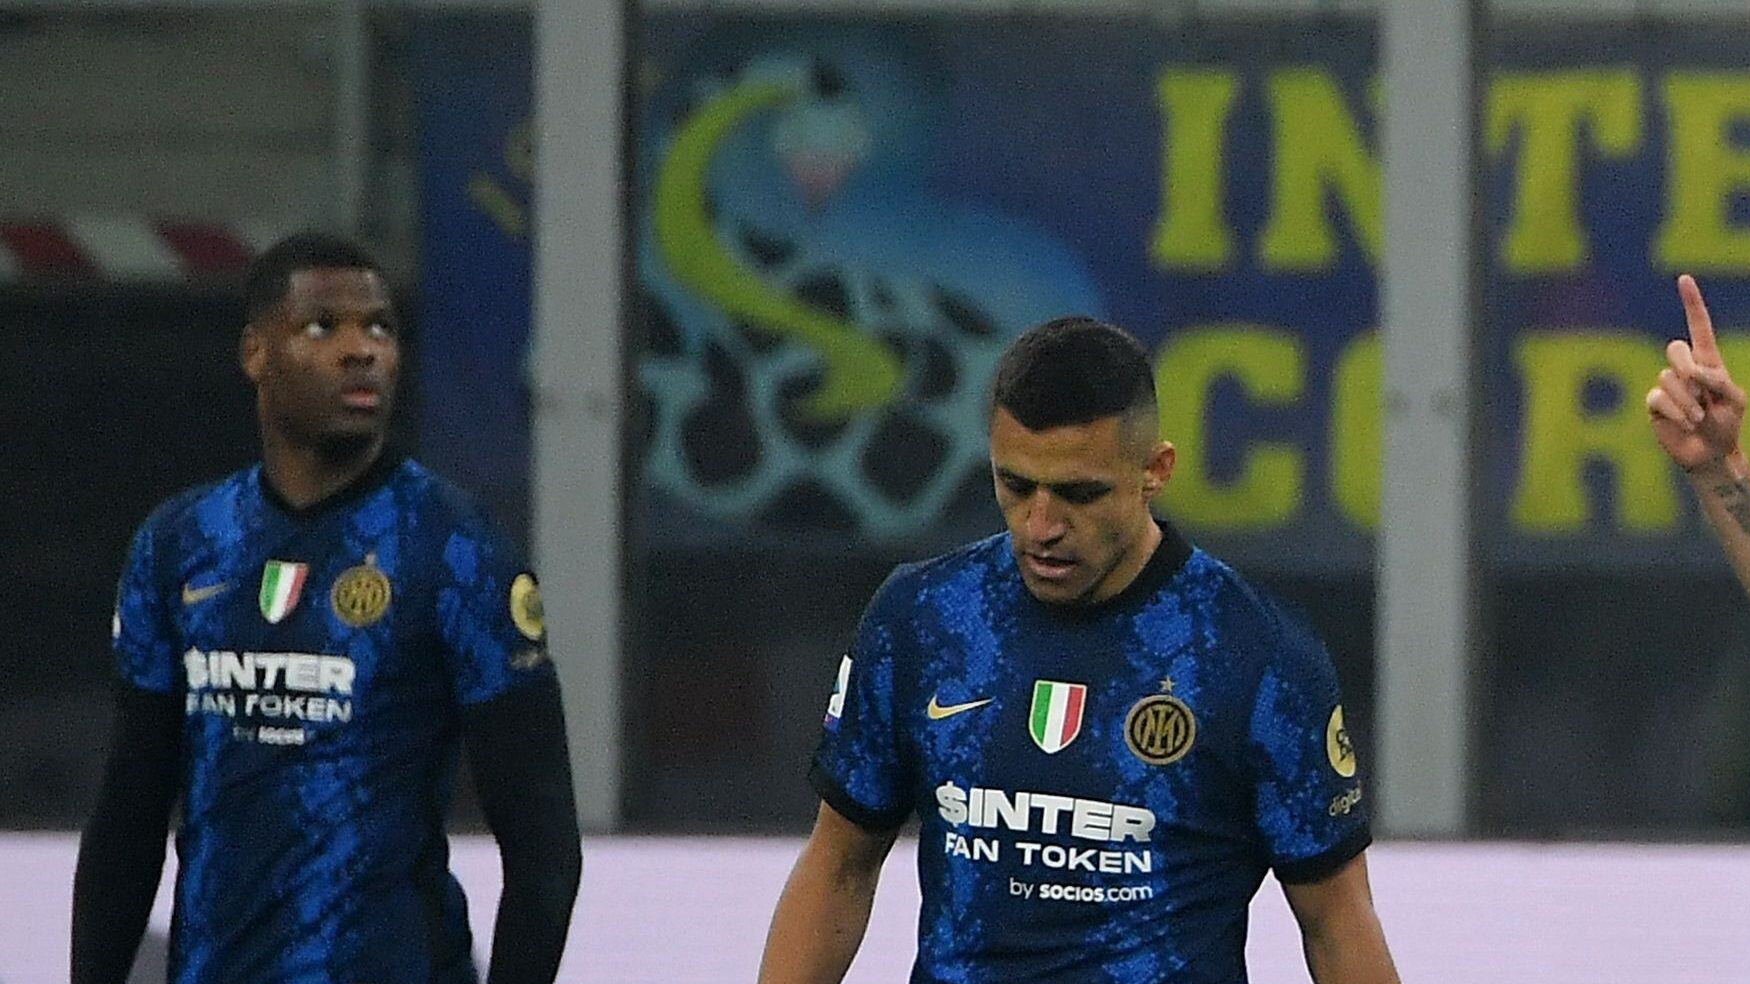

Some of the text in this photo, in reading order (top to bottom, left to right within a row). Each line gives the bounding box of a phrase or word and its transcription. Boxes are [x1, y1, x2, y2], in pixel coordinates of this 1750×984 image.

[185, 692, 353, 723] FAN TOKEN
[935, 780, 1156, 843] $INTER
[945, 831, 1152, 874] FAN TOKEN
[1009, 876, 1154, 903] by socios.com
